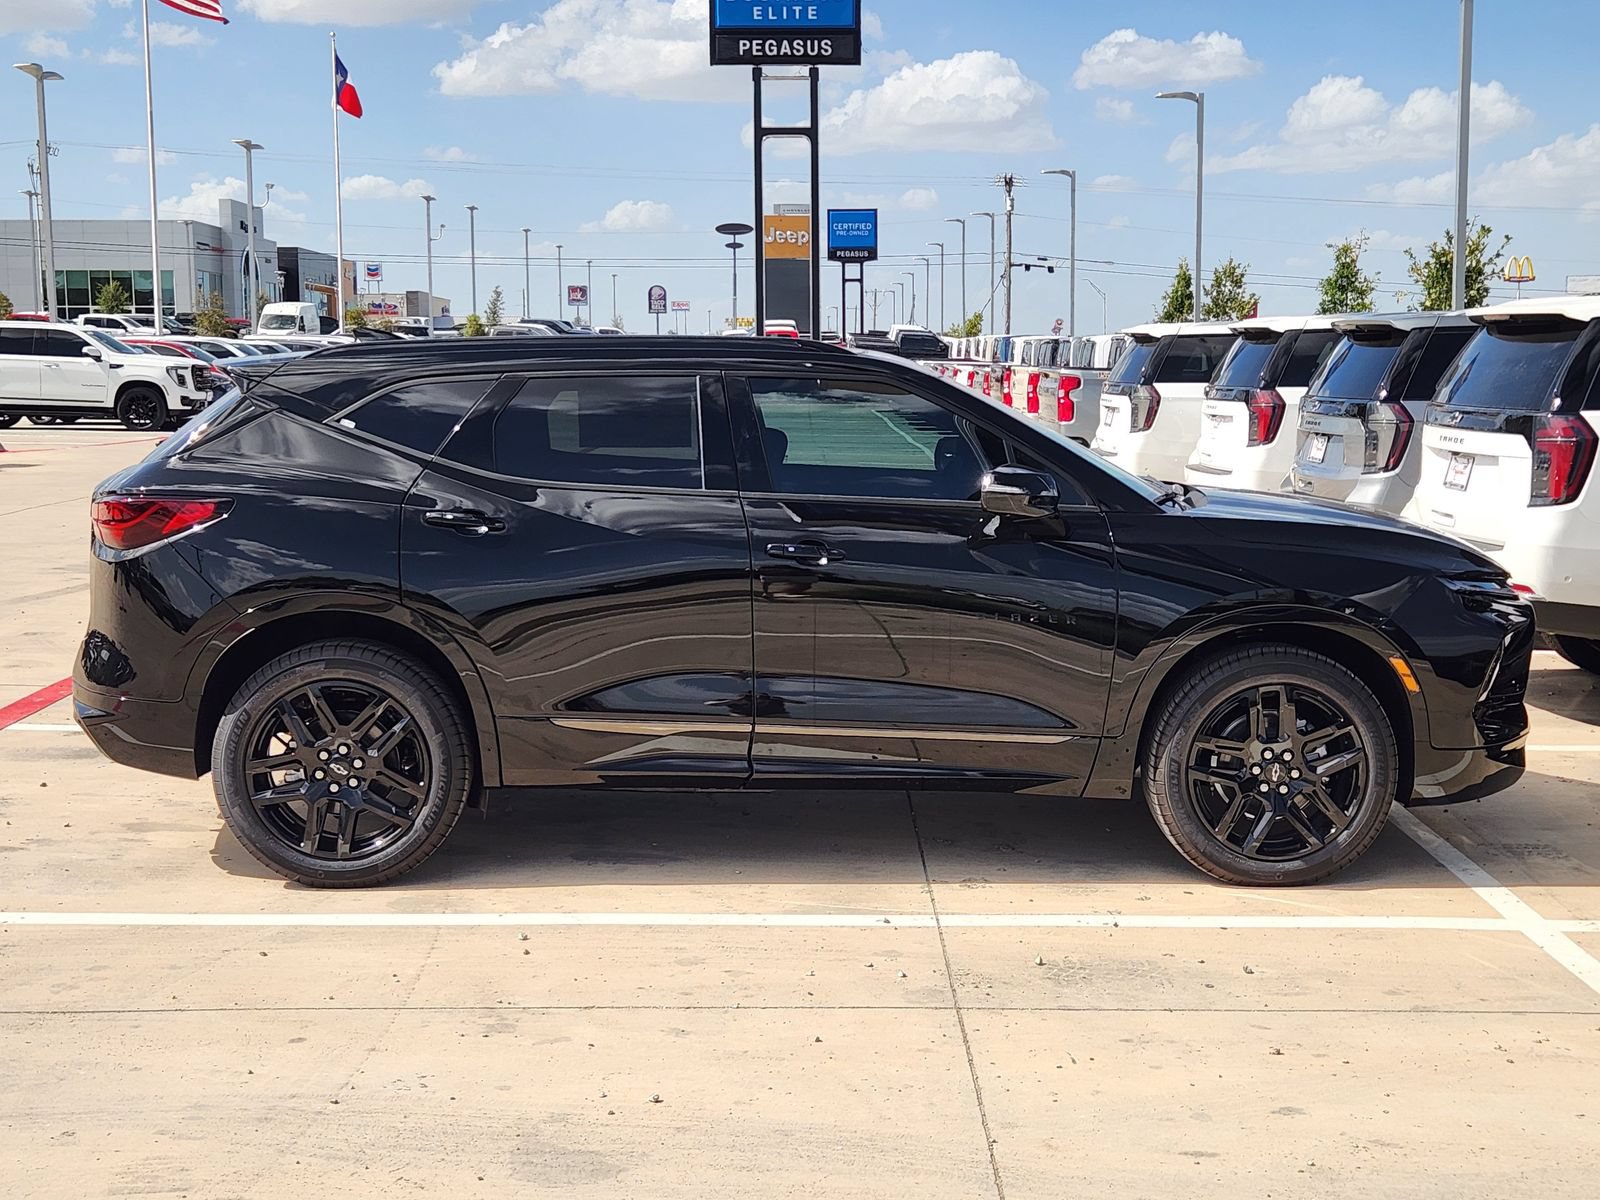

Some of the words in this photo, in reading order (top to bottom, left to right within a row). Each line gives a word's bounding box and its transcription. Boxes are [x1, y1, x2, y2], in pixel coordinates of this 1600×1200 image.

[753, 6, 817, 19] ELITE
[739, 39, 832, 56] PEGASUS
[764, 227, 809, 246] Jeep
[1440, 435, 1465, 444] TAHOE
